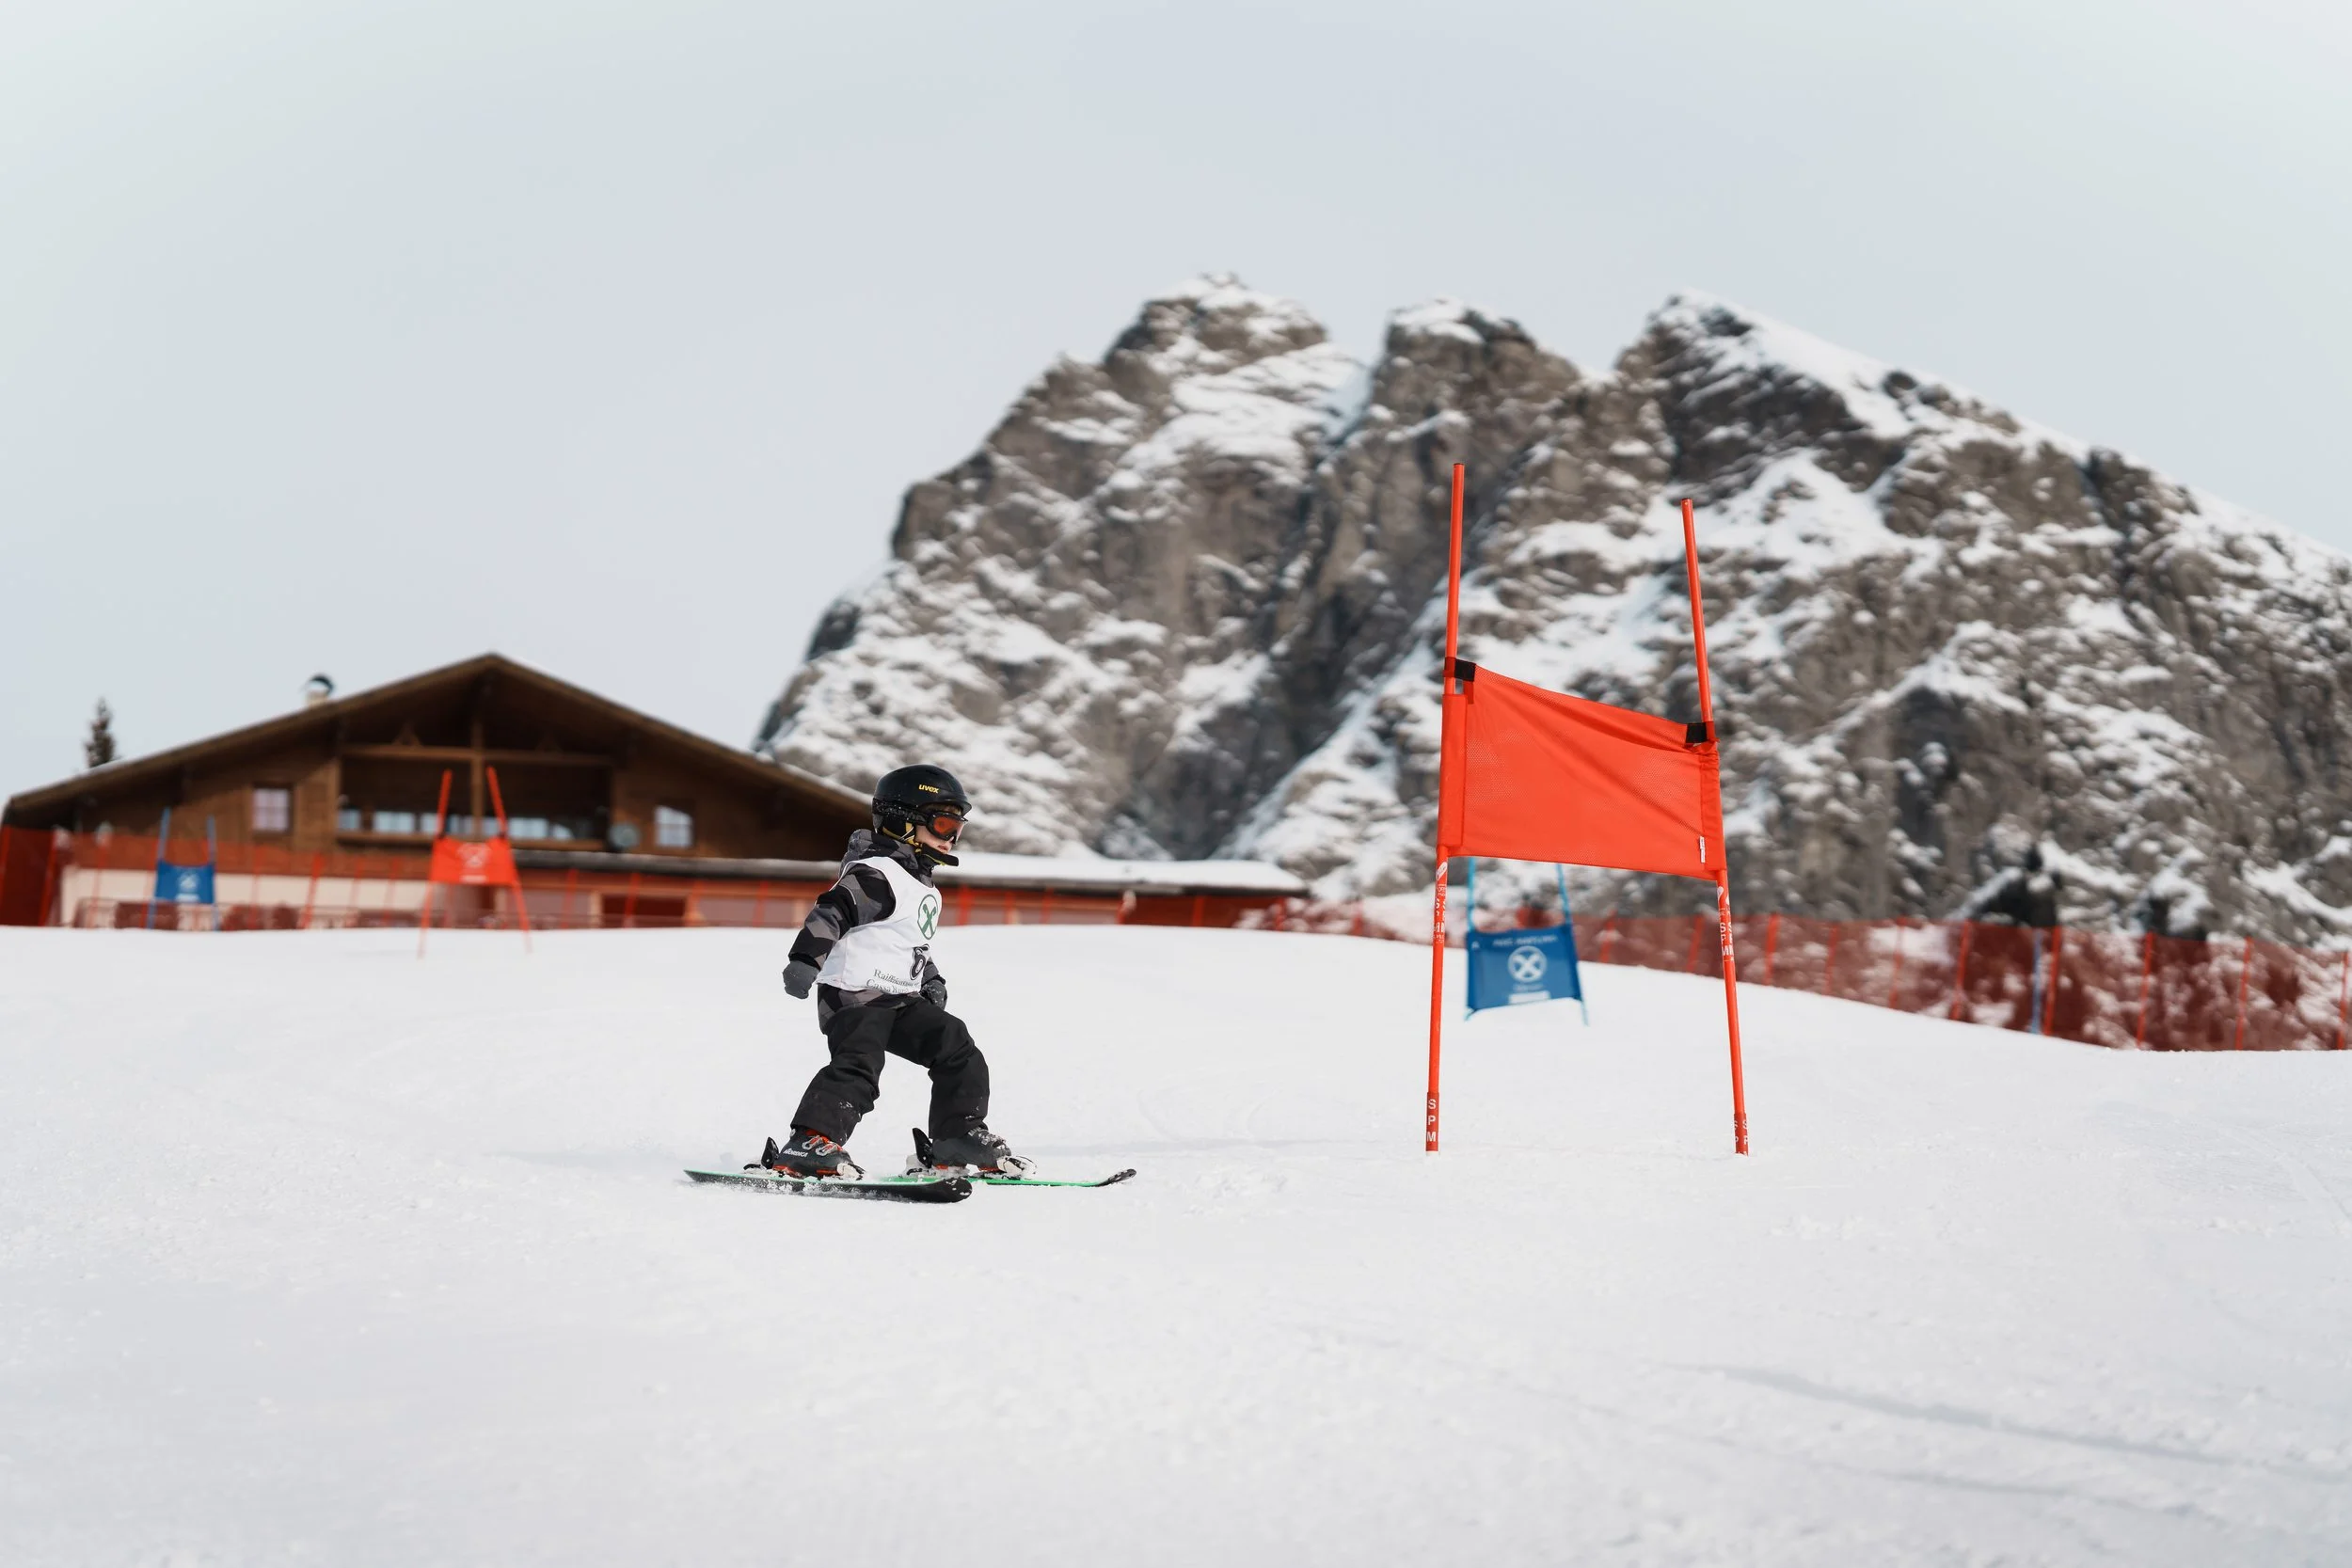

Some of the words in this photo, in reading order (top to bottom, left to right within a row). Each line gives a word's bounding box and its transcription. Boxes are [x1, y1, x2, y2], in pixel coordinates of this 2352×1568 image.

[918, 784, 939, 794] uvex
[866, 978, 891, 994] Cassa
[1426, 1098, 1437, 1142] SPM
